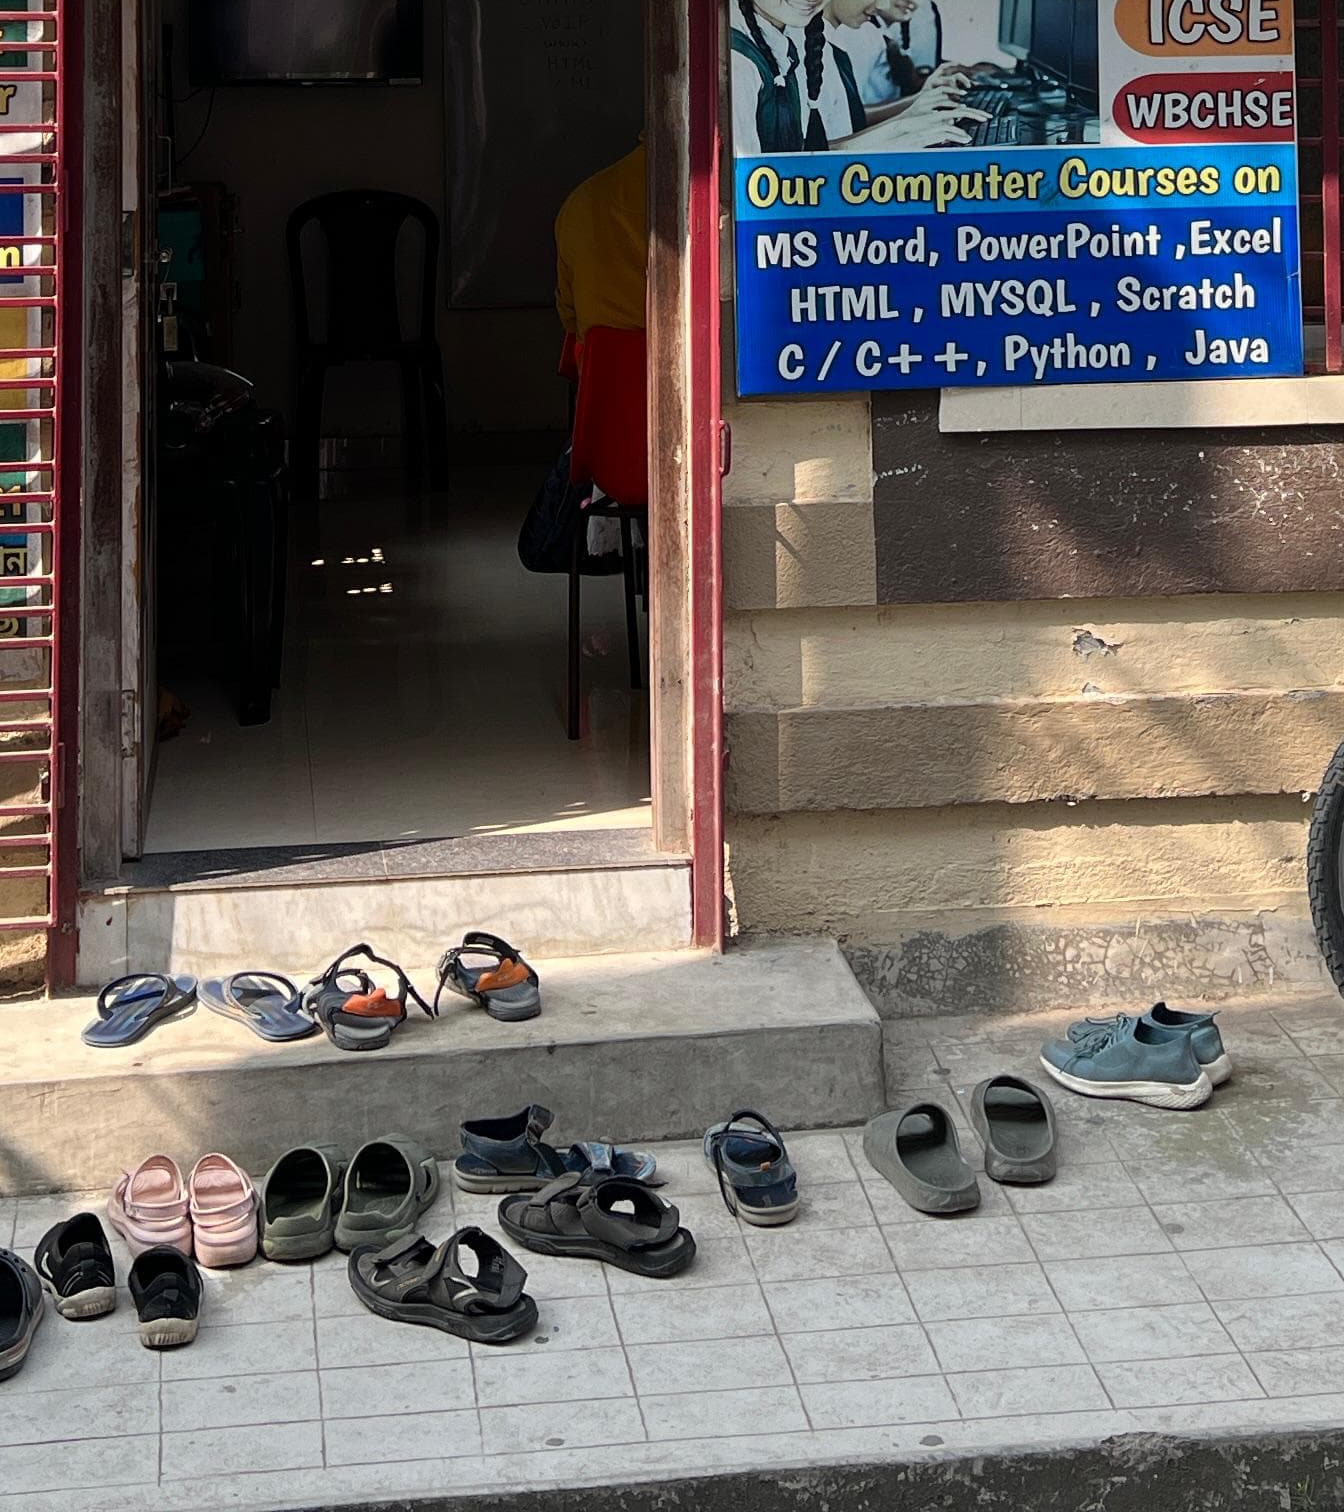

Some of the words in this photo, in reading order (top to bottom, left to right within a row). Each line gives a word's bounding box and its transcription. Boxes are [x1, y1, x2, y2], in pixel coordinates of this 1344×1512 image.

[1127, 89, 1294, 131] WBCHSE
[747, 165, 825, 208] Our
[841, 163, 1045, 213] Computer
[1059, 158, 1220, 198] Courses
[1233, 164, 1281, 194] on
[756, 233, 817, 269] MS
[832, 225, 939, 268] Word,
[957, 223, 1162, 262] PowerPoint
[791, 284, 899, 323] HTML
[941, 280, 1077, 318] MYSQL
[1116, 274, 1255, 312] Scratch
[777, 343, 805, 380] C
[1004, 334, 1131, 381] Python
[1184, 329, 1270, 367] Java
